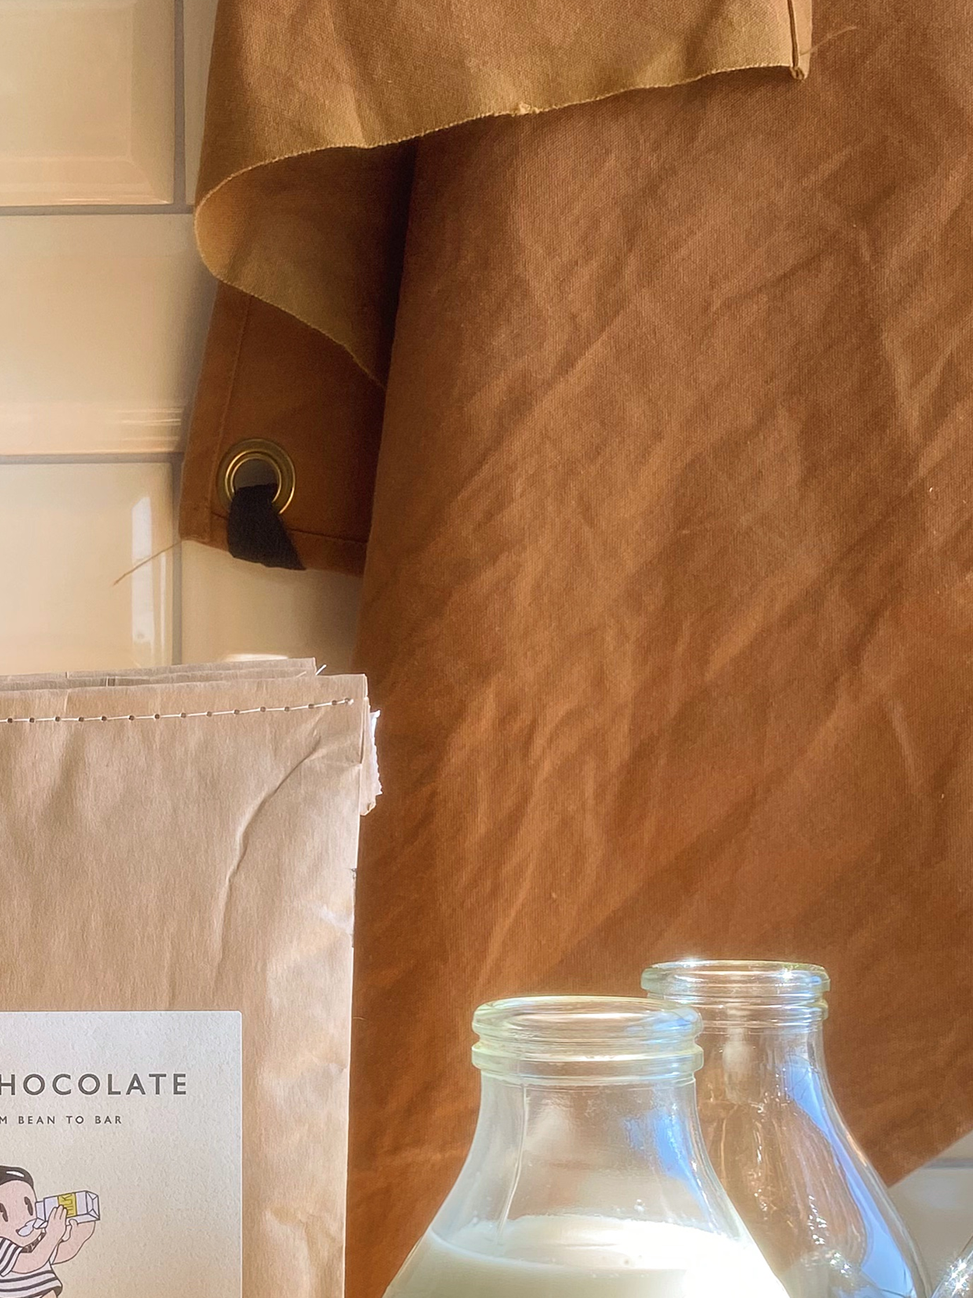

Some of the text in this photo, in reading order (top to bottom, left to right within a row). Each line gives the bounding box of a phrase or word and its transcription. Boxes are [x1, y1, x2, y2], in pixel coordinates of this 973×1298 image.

[18, 1115, 56, 1124] BEAN
[67, 1115, 84, 1124] TO
[95, 1115, 123, 1124] BAR
